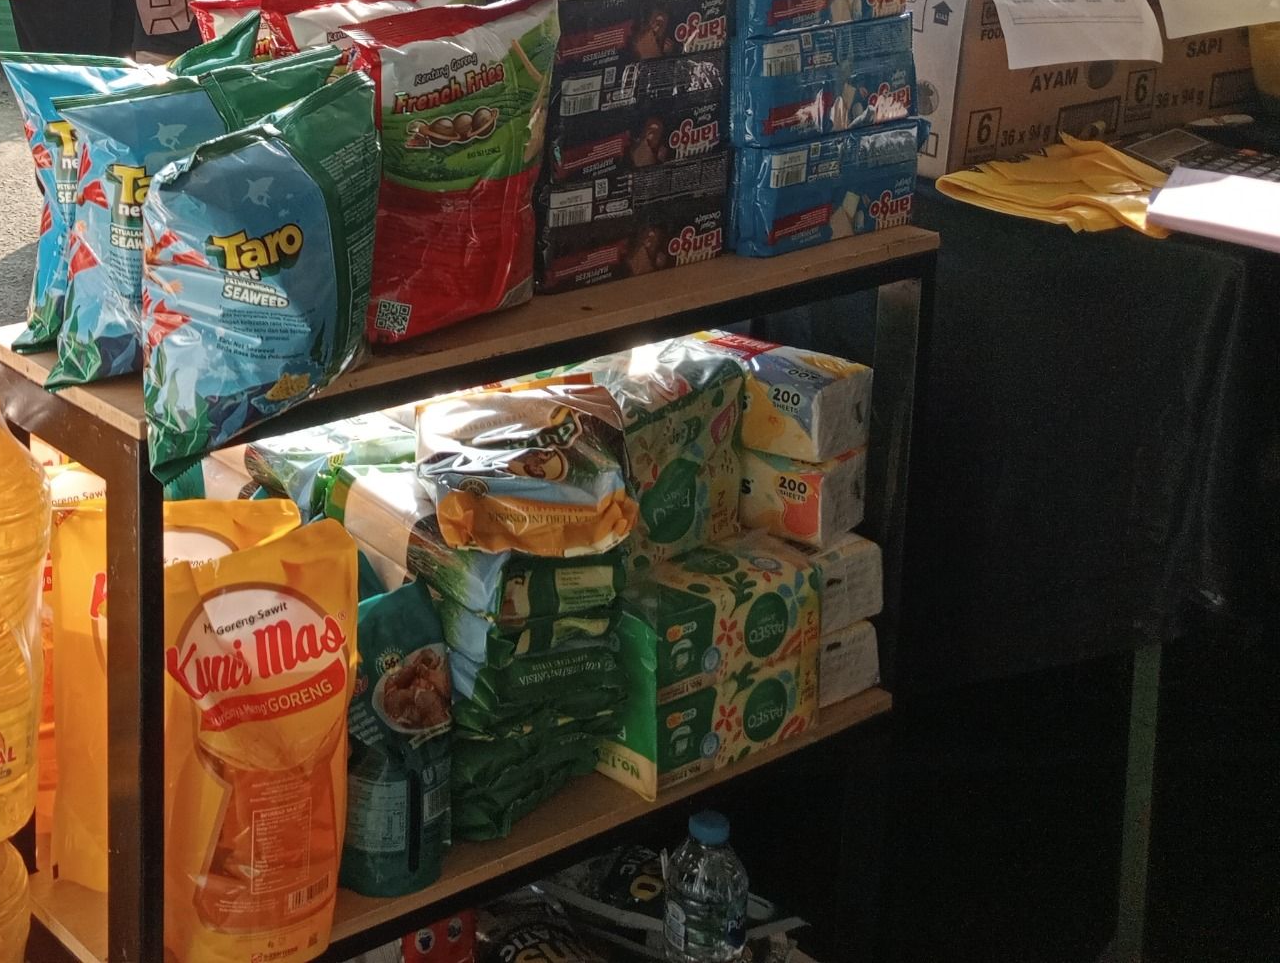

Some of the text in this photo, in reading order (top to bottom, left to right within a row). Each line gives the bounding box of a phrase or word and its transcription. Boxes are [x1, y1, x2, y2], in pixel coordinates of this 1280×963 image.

[1185, 38, 1222, 58] SAPI
[414, 53, 478, 87] Kentang Goreng
[1030, 67, 1078, 93] AYAM
[394, 62, 504, 115] French Fries
[1133, 74, 1148, 104] 6
[977, 113, 993, 145] 6
[111, 226, 144, 237] PETUALAN
[111, 234, 144, 250] SEAW
[667, 225, 722, 256] Tango
[209, 224, 302, 271] Taro
[223, 284, 289, 308] SEAWEED
[772, 386, 801, 406] 200
[778, 475, 807, 494] 200
[216, 614, 256, 636] Goreng
[257, 601, 288, 622] Sawit
[253, 615, 346, 679] Mas
[267, 678, 333, 713] GORENG
